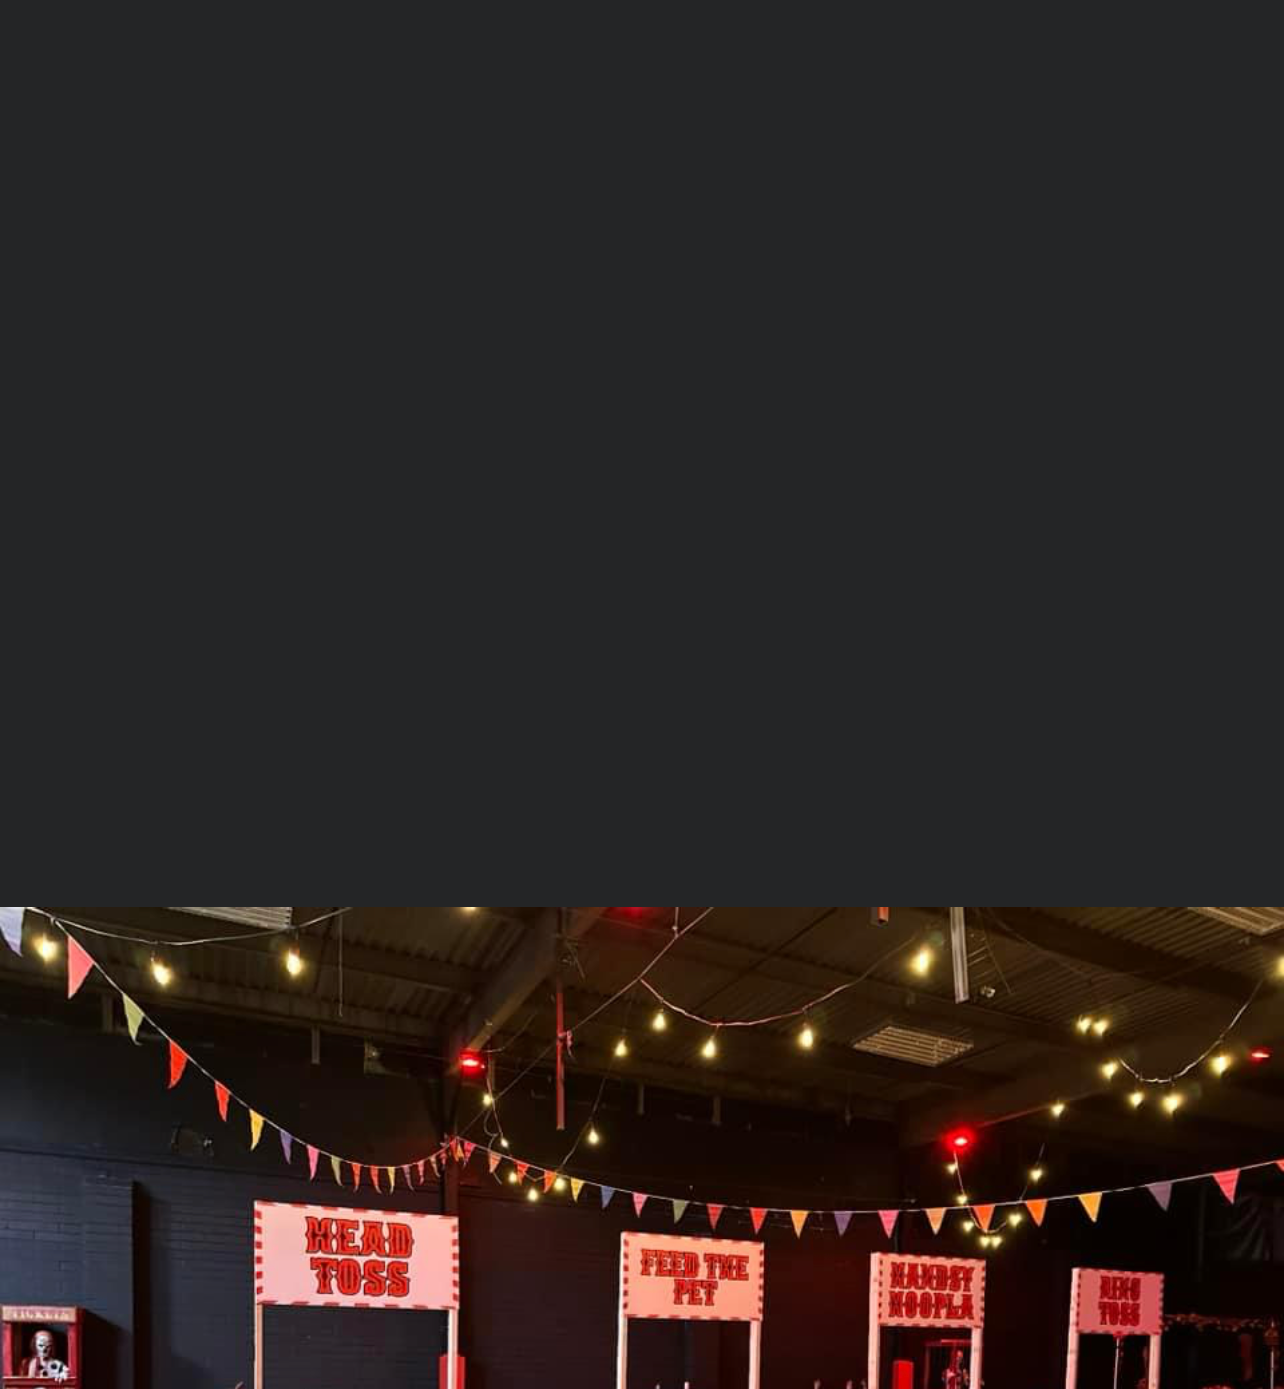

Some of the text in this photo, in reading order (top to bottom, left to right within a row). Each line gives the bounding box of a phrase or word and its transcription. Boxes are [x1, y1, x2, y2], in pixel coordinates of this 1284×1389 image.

[305, 1216, 415, 1258] HEAD
[310, 1257, 411, 1297] TOSS
[641, 1248, 750, 1281] FEED THE
[673, 1278, 718, 1306] PET
[888, 1290, 974, 1320] HOOPLA
[1098, 1301, 1140, 1326] TOSS
